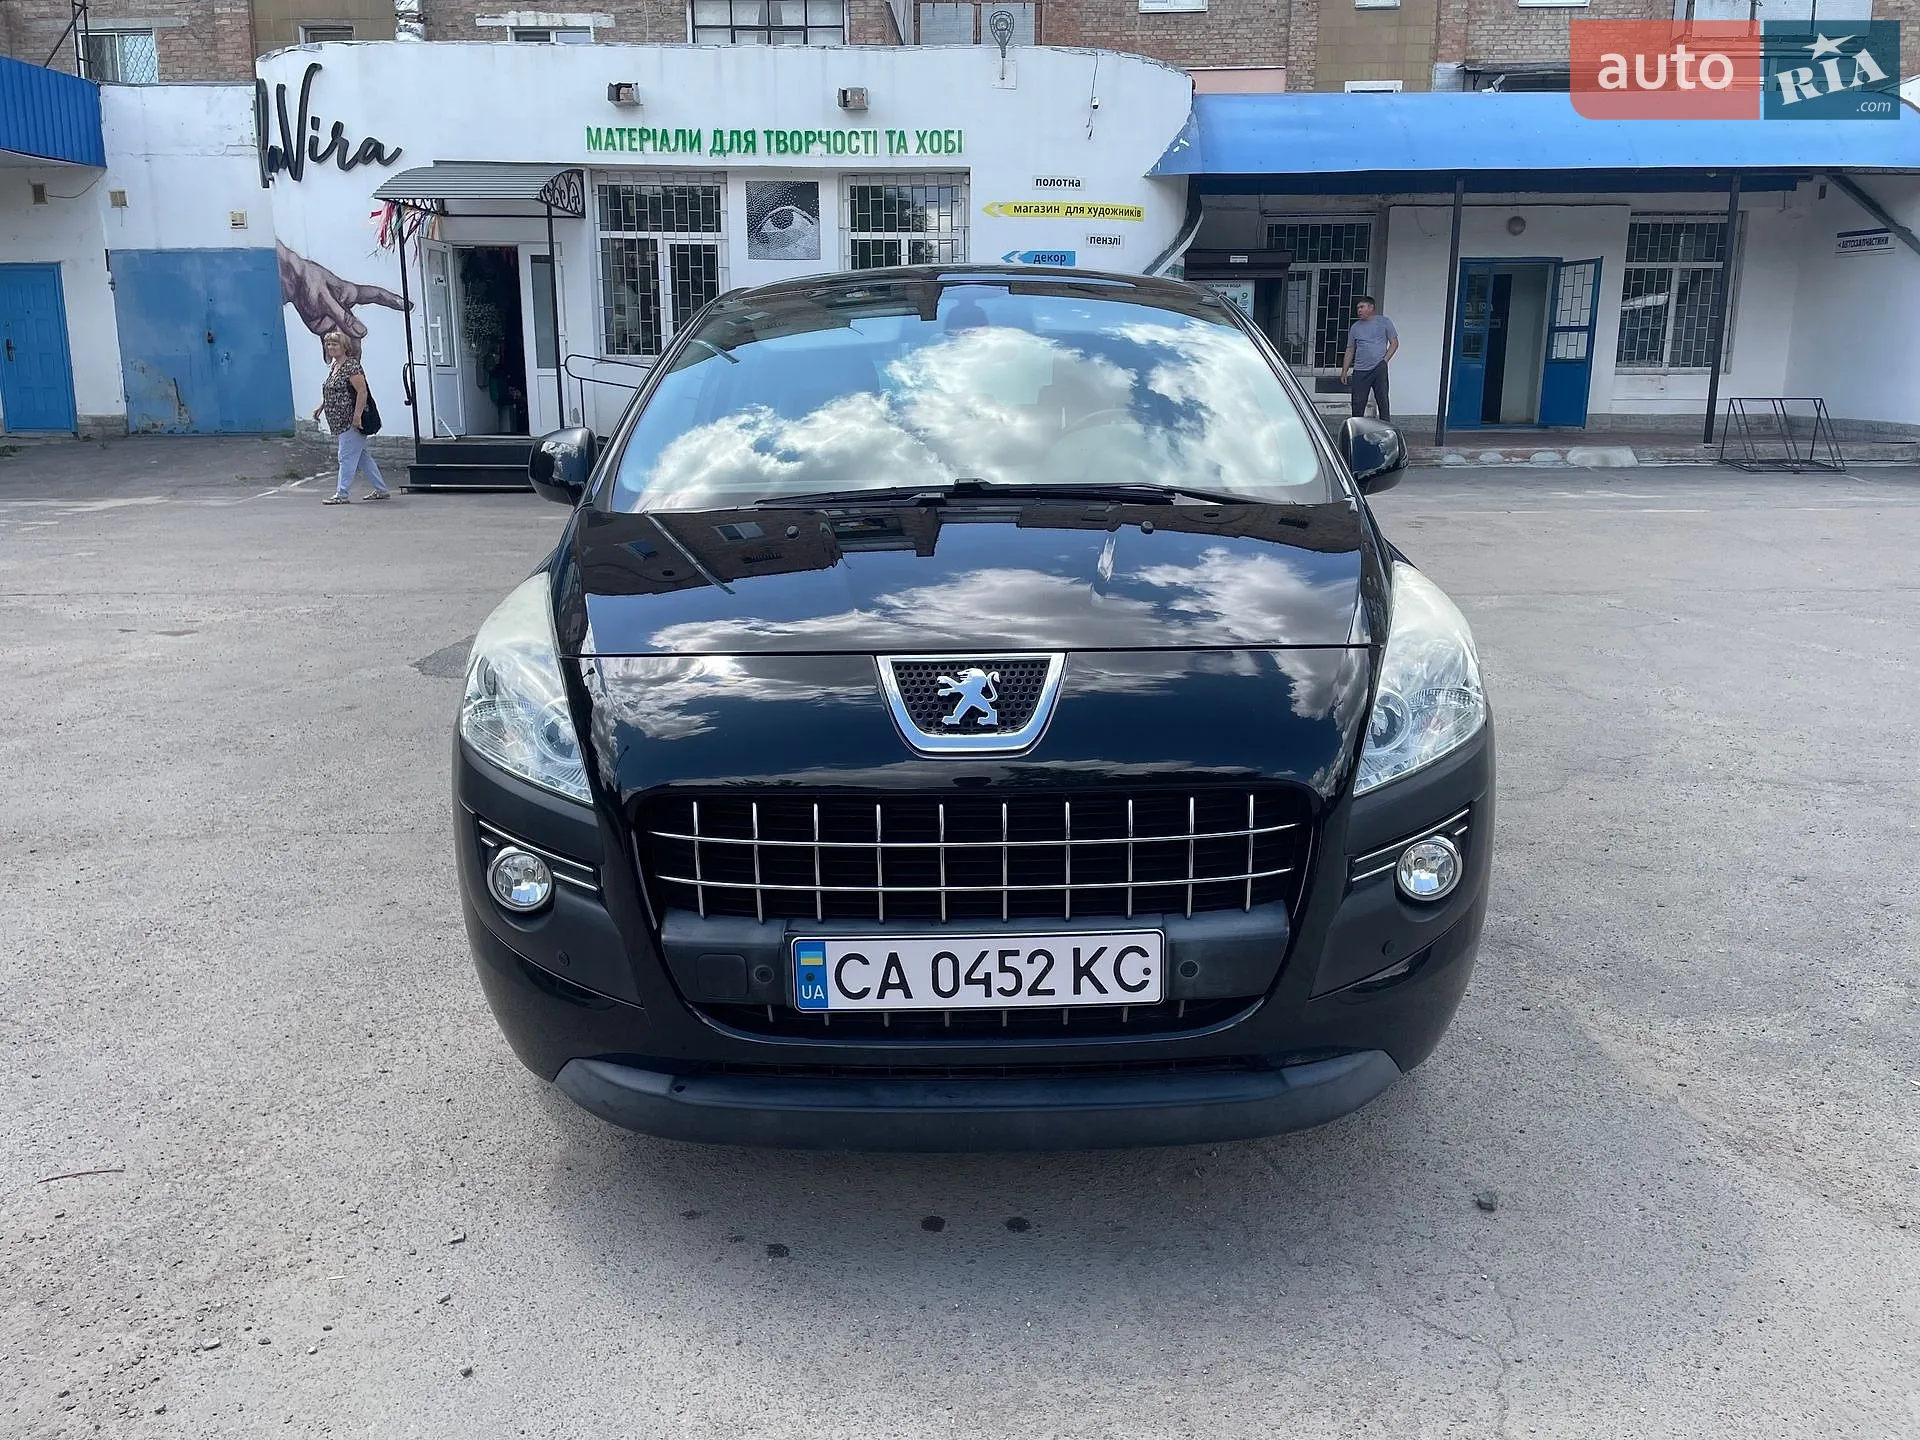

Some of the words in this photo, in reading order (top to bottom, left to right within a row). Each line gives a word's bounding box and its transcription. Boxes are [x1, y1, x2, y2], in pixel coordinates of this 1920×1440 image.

[586, 126, 702, 153] МАТЕРІАЛИ
[709, 128, 757, 158] ДЛЯ
[763, 129, 878, 155] ТВОРЧОСТІ
[885, 129, 909, 154] ТА
[915, 129, 963, 154] ХОБІ
[1035, 177, 1081, 188] полотна
[1013, 204, 1060, 214] магазин
[1065, 205, 1085, 216] для
[1087, 206, 1142, 219] художників
[1089, 234, 1121, 246] пензлі
[1033, 253, 1067, 266] декор
[834, 952, 913, 1000] CA
[931, 948, 1055, 999] 0452
[1072, 945, 1149, 996] KC
[801, 984, 825, 1000] UA
